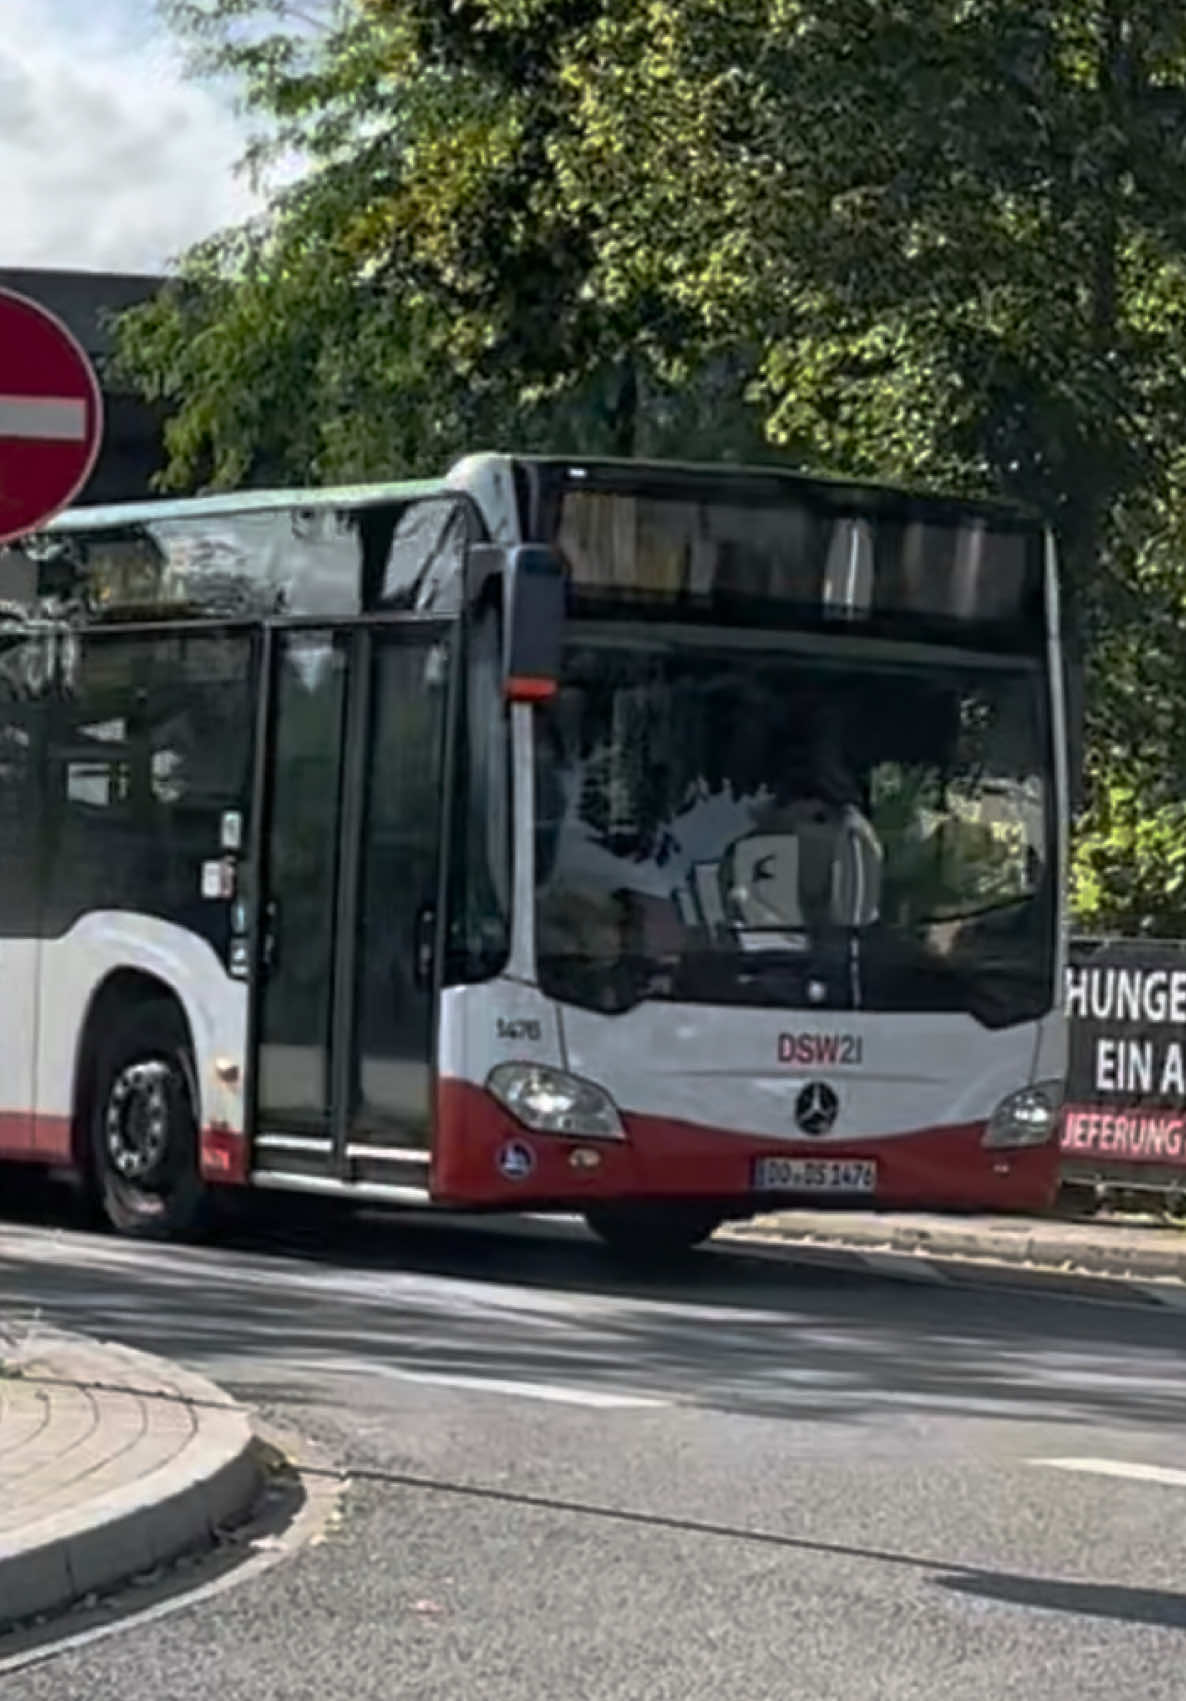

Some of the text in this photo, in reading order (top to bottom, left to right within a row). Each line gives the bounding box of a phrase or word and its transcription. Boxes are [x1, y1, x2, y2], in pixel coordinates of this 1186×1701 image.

[1064, 967, 1186, 1022] HUNGE
[778, 1033, 862, 1064] DSW21
[1096, 1039, 1152, 1093] EIN
[1061, 1112, 1184, 1156] IEFERUNG
